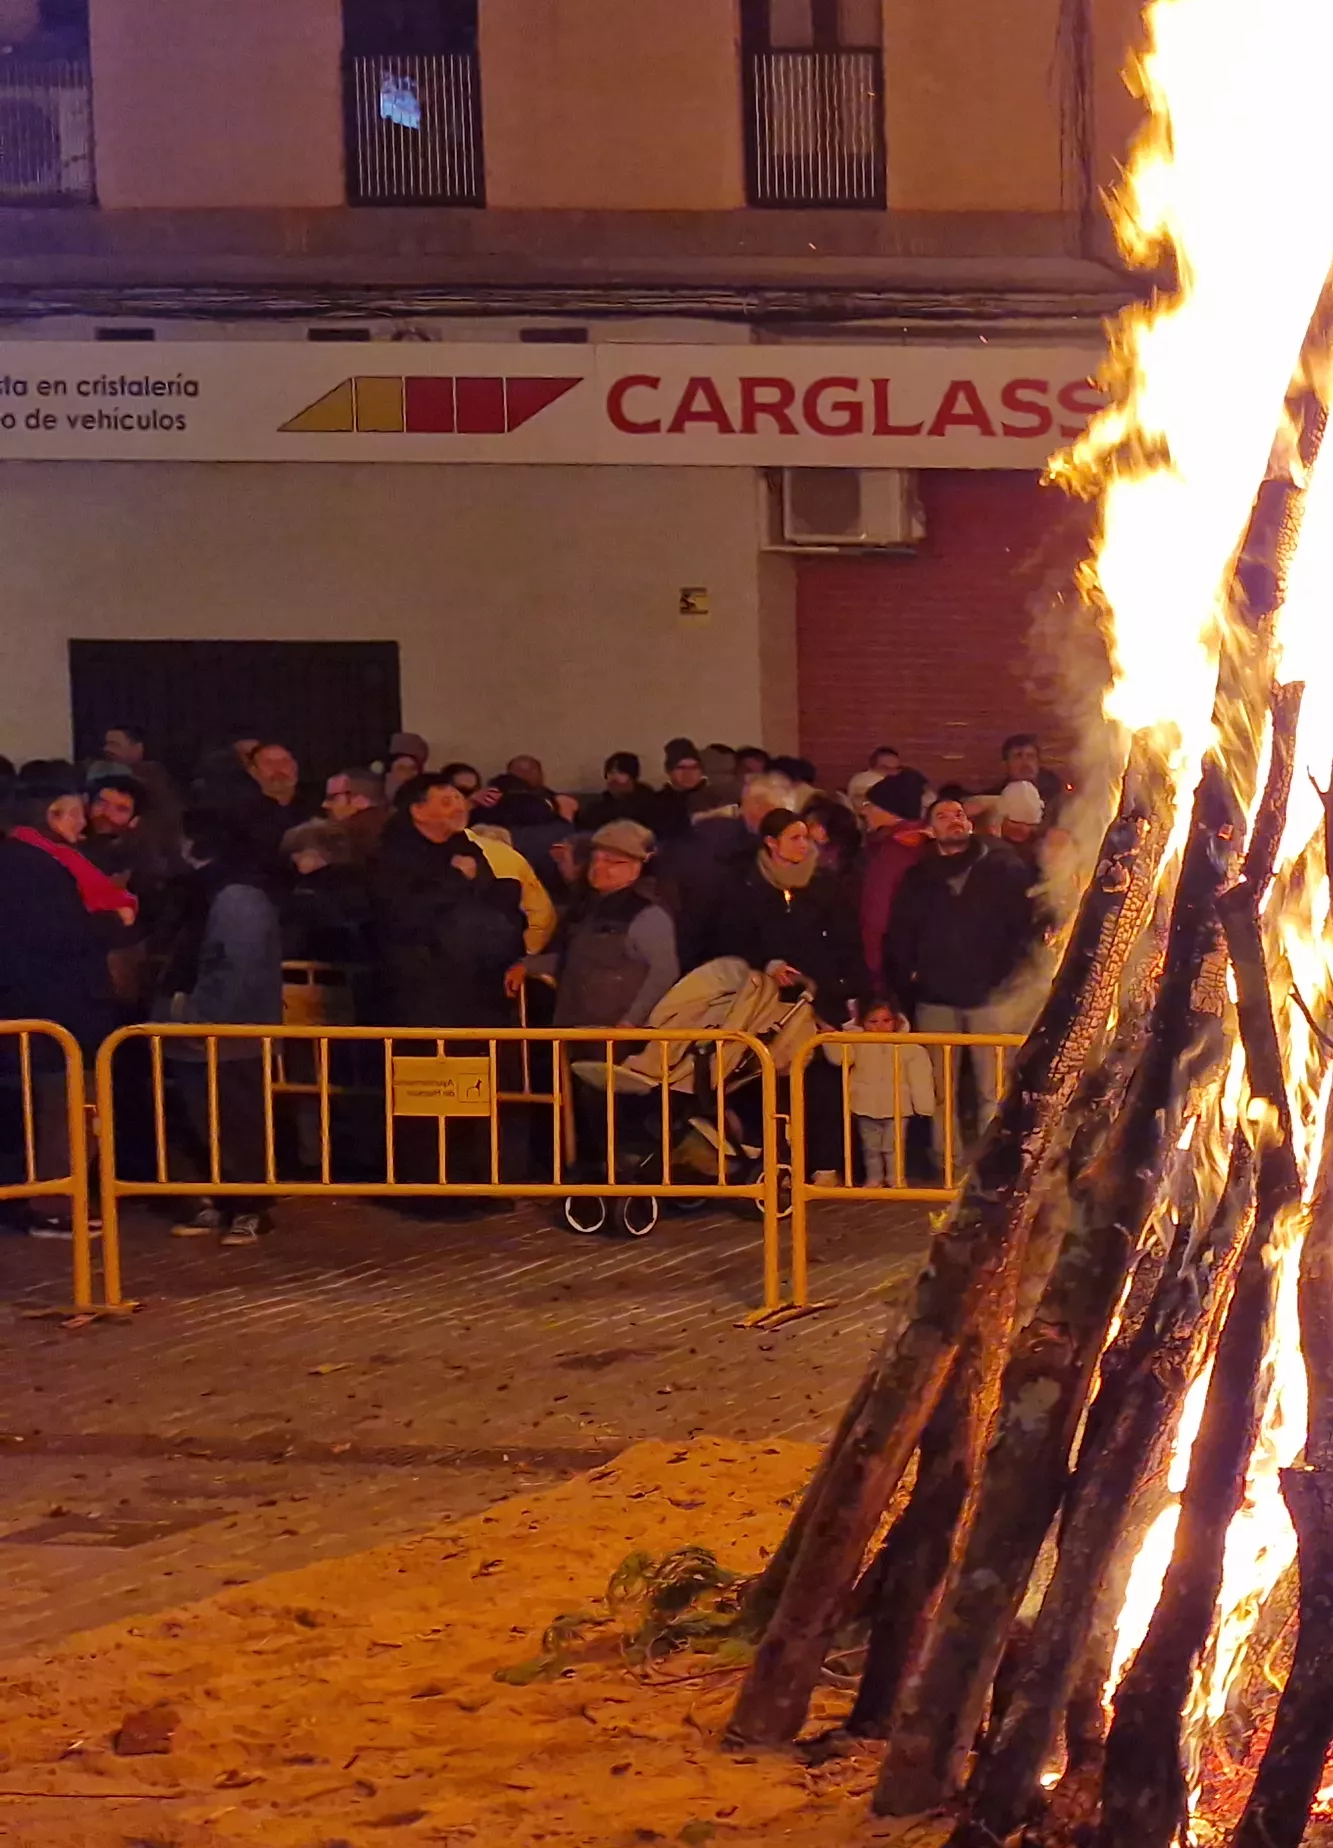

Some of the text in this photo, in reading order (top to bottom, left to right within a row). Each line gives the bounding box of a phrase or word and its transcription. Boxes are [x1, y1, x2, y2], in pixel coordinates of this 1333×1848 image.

[37, 380, 67, 396] en
[76, 373, 199, 396] cristalería
[606, 374, 1106, 438] CARGLASS
[25, 408, 57, 430] de
[67, 407, 187, 430] vehículos
